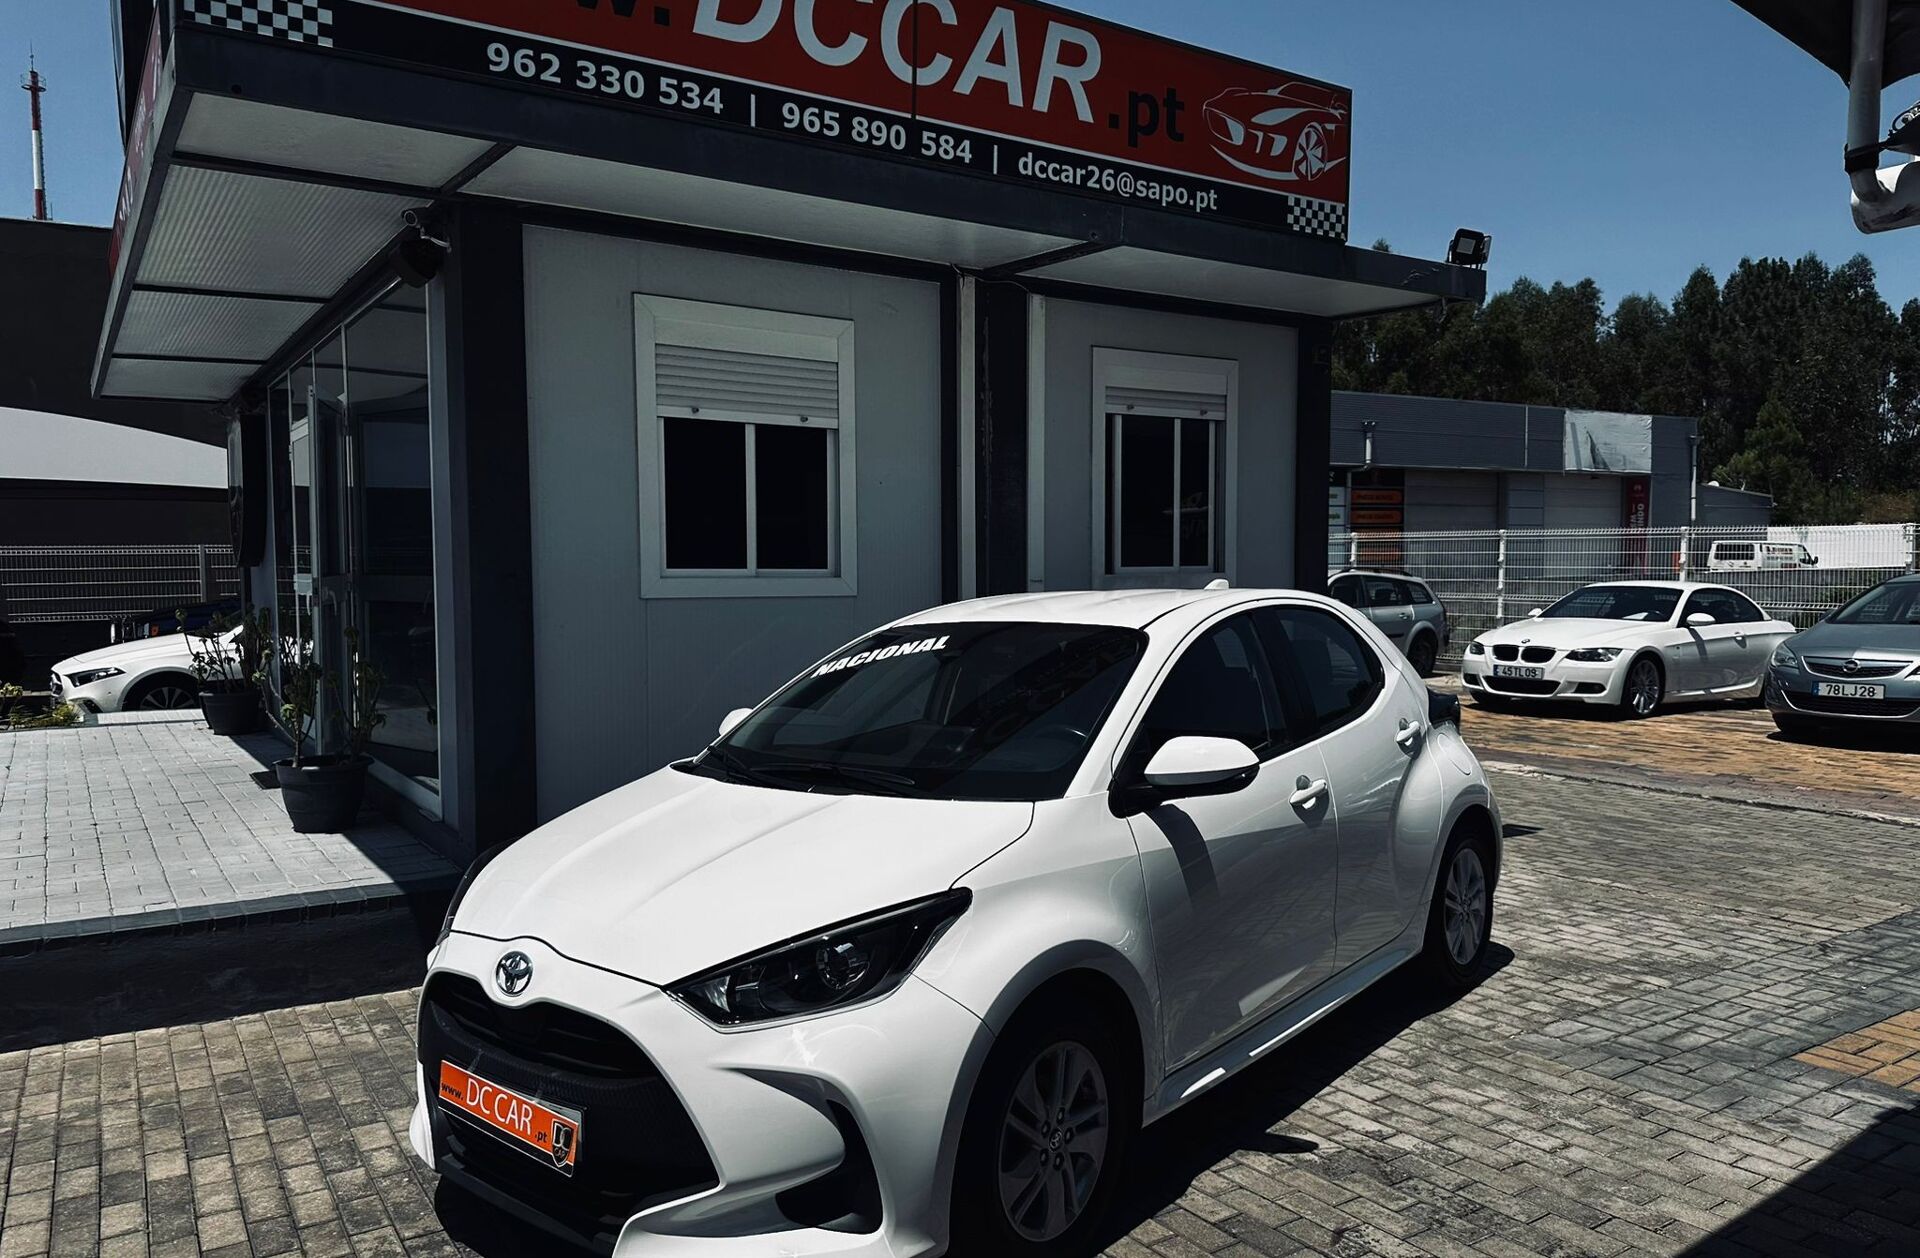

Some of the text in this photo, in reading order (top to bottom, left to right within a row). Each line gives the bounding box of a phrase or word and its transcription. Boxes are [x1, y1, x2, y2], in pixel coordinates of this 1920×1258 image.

[486, 42, 562, 84] 962
[575, 60, 645, 99] 330
[658, 76, 724, 114] 534
[781, 102, 840, 137] 965
[851, 116, 907, 150] 890
[920, 130, 972, 164] 584
[1018, 151, 1218, 212] dccar26@sapo.pt
[810, 635, 950, 679] NACIONAL
[1826, 684, 1876, 698] 78LJ28
